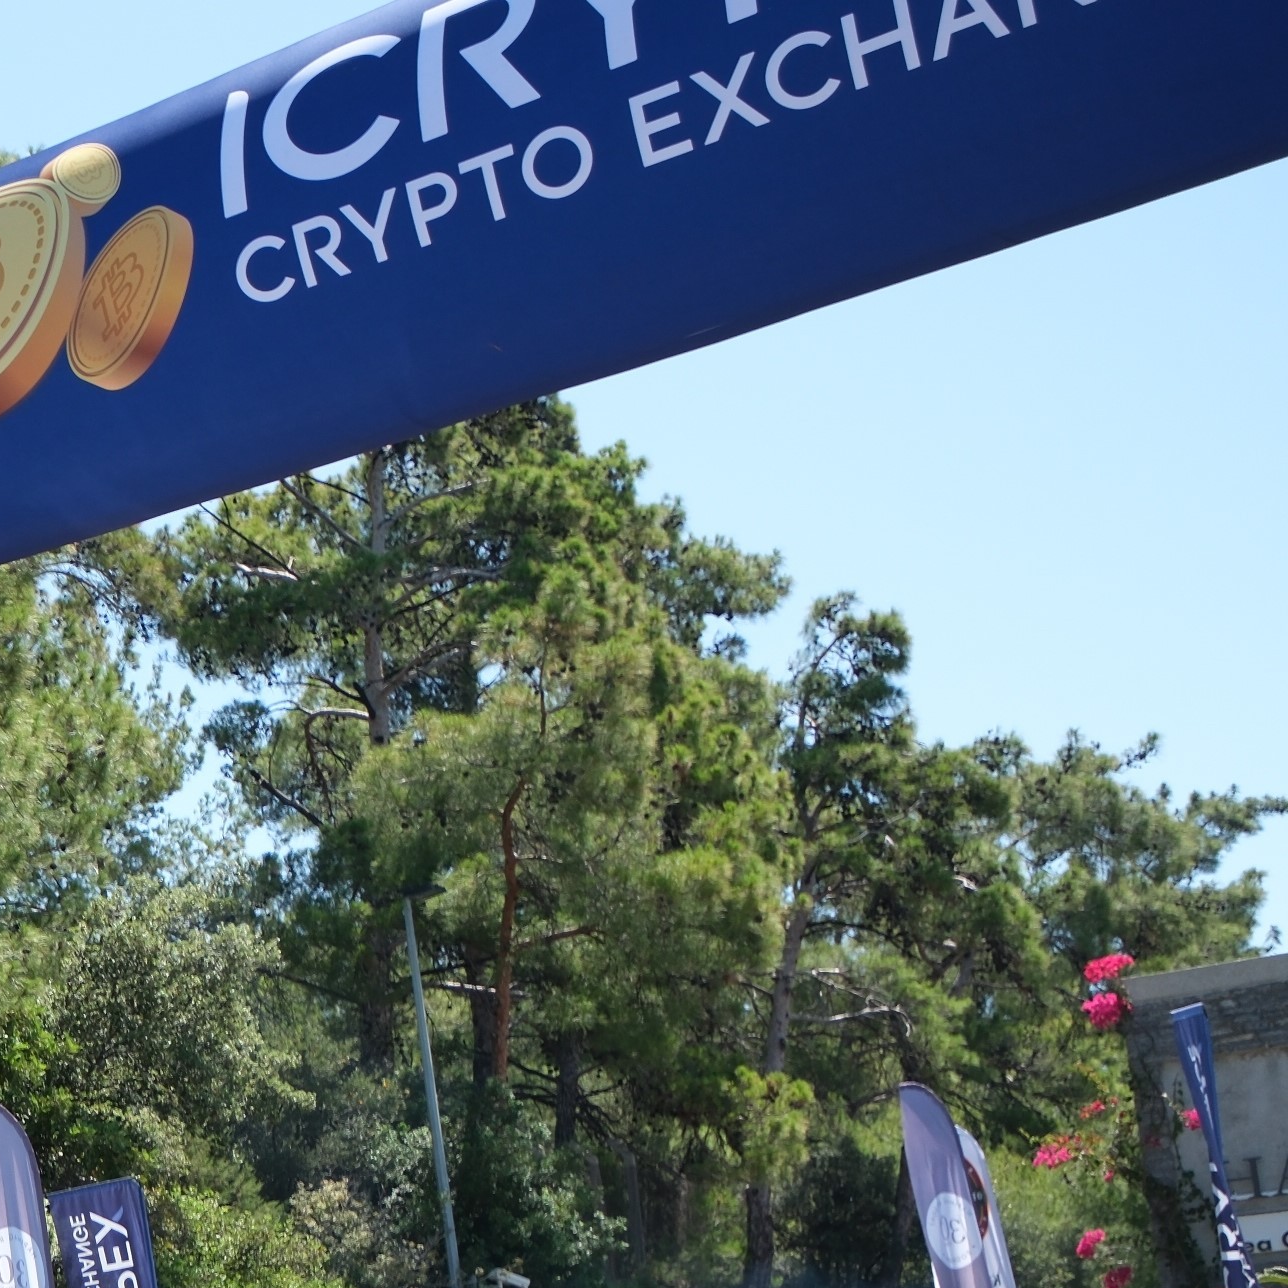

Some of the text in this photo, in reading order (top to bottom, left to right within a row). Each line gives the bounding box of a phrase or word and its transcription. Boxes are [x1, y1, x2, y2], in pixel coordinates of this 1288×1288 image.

[220, 0, 758, 219] ICRY
[235, 0, 1099, 302] CRYPTO EXCHA
